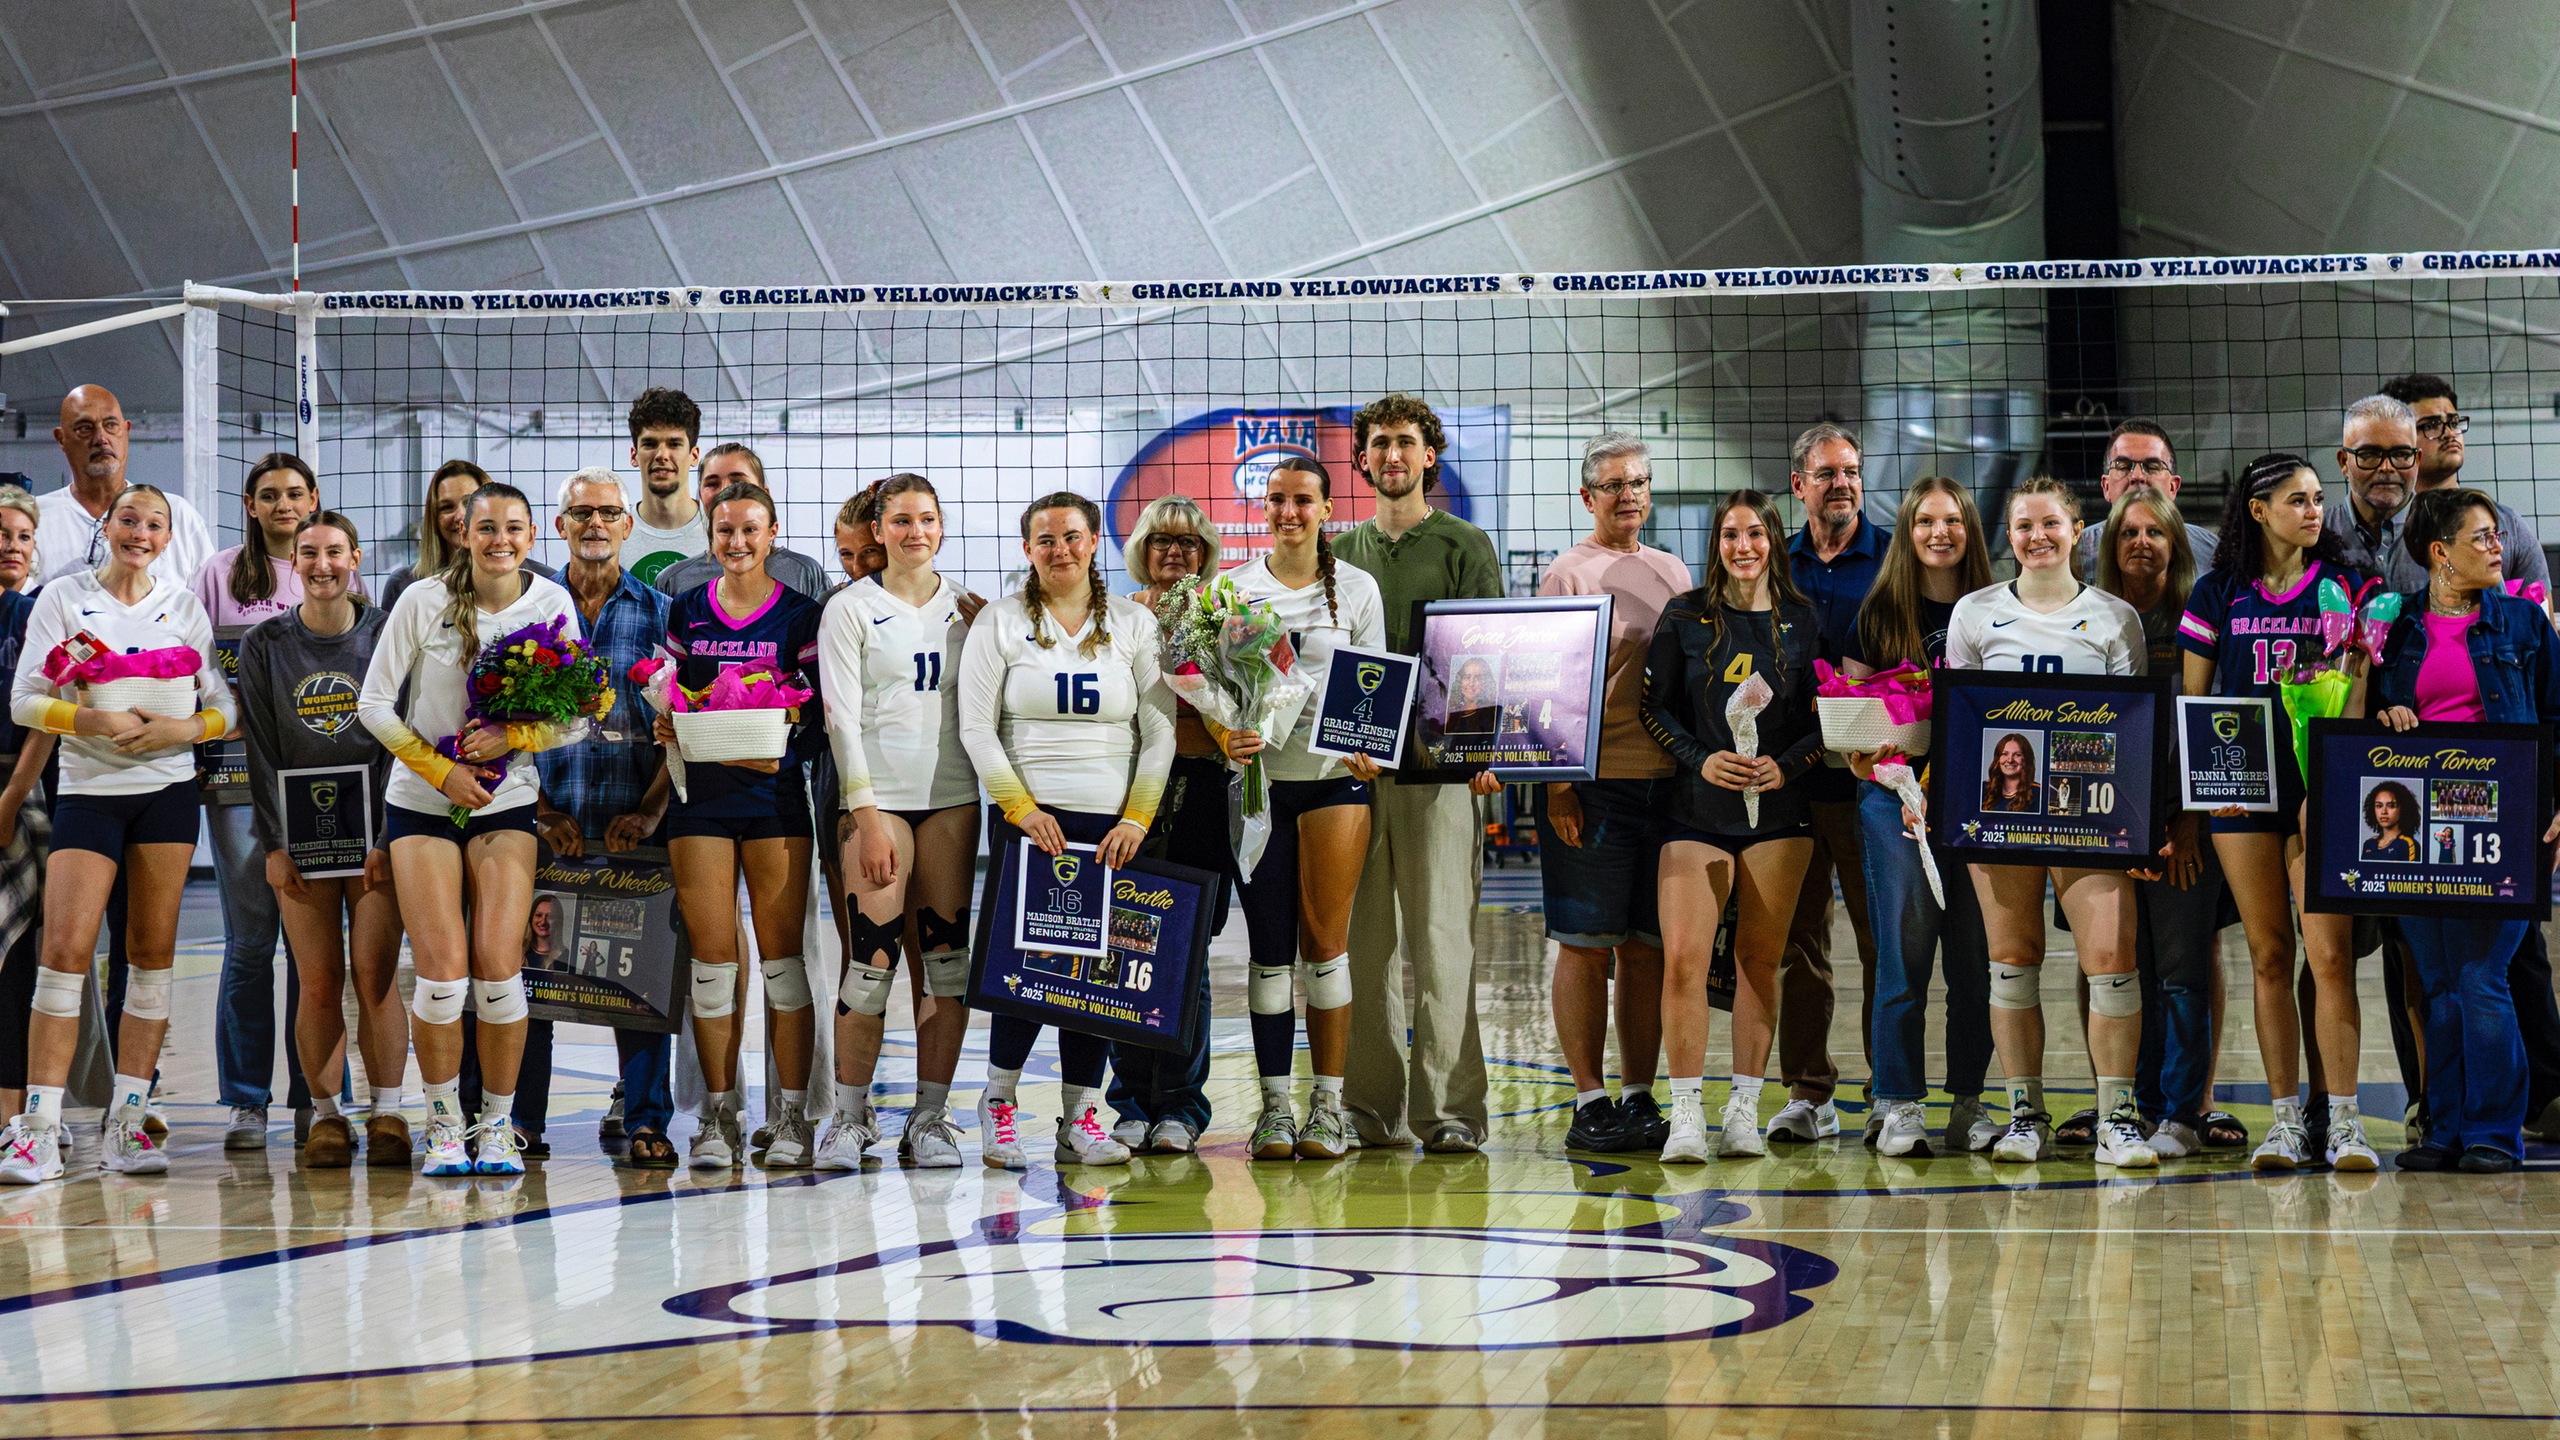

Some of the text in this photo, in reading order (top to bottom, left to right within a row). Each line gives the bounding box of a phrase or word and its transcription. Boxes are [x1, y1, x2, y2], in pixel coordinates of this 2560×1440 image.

[1553, 267, 1930, 291] GRACELAND YELLOWJACKETS
[1985, 256, 2368, 281] GRACELAND YELLOWJACKETS
[324, 290, 671, 310] GRACELAND YELLOWJACKETS
[719, 285, 1079, 306] GRACELAND YELLOWJACKETS
[1132, 276, 1500, 300] GRACELAND YELLOWJACKETS
[1235, 418, 1319, 458] NAIA
[1461, 625, 1506, 649] Grace
[2231, 617, 2321, 636] GRACELAND
[691, 640, 778, 657] GRACELAND
[914, 652, 941, 692] 11
[1723, 652, 1753, 684] 4
[2252, 639, 2297, 685] 13
[302, 692, 354, 706] WOMEN'S
[1054, 672, 1101, 715] 16
[1352, 697, 1373, 723] 4
[1538, 699, 1552, 730] 4
[1985, 699, 2118, 725] Allison Sander
[1323, 717, 1397, 740] GRACE JENSEN
[1322, 733, 1391, 753] SENIOR 2025
[1444, 752, 1464, 763] 2025
[1465, 751, 1502, 763] WOMEN'S
[1504, 750, 1552, 763] VOLLEYBALL
[2210, 745, 2247, 771] 13
[2367, 746, 2497, 772] Danna Torres
[208, 773, 230, 784] 2025
[2190, 770, 2269, 782] DANNA TORRES
[2087, 782, 2115, 815] 10
[2196, 787, 2266, 796] SENIOR 2025
[315, 814, 337, 840] 5
[1994, 824, 2100, 835] GRACELAND UNIVERSITY
[331, 838, 365, 849] WHEELER
[1981, 831, 2005, 843] 2025
[2006, 832, 2051, 845] WOMEN'S
[2053, 834, 2110, 848] VOLLEYBALL
[2471, 832, 2502, 865] 13
[295, 854, 362, 867] SENIOR 2025
[594, 868, 672, 894] Wheeler
[2361, 881, 2386, 893] 2025
[2387, 881, 2433, 894] WOMEN'S
[2435, 883, 2495, 897] VOLLEYBALL
[2374, 873, 2483, 883] GRACELAND UNIVERSITY
[1047, 887, 1083, 915] 16
[1113, 879, 1175, 911] Bratlie
[1026, 911, 1101, 928] MADISON BRATLIE
[1028, 926, 1097, 942] SENIOR 2025
[617, 946, 633, 977] 5
[1124, 958, 1154, 993] 16
[535, 987, 577, 1003] WOMEN'S
[578, 992, 632, 1009] VOLLEYBALL
[574, 984, 623, 995] UNIVERSITY
[1034, 982, 1134, 1009] GRACELAND UNIVERSITY
[1020, 986, 1043, 1001] 2025
[1045, 991, 1087, 1011] WOMEN'S
[1088, 1001, 1142, 1024] VOLLEYBALL
